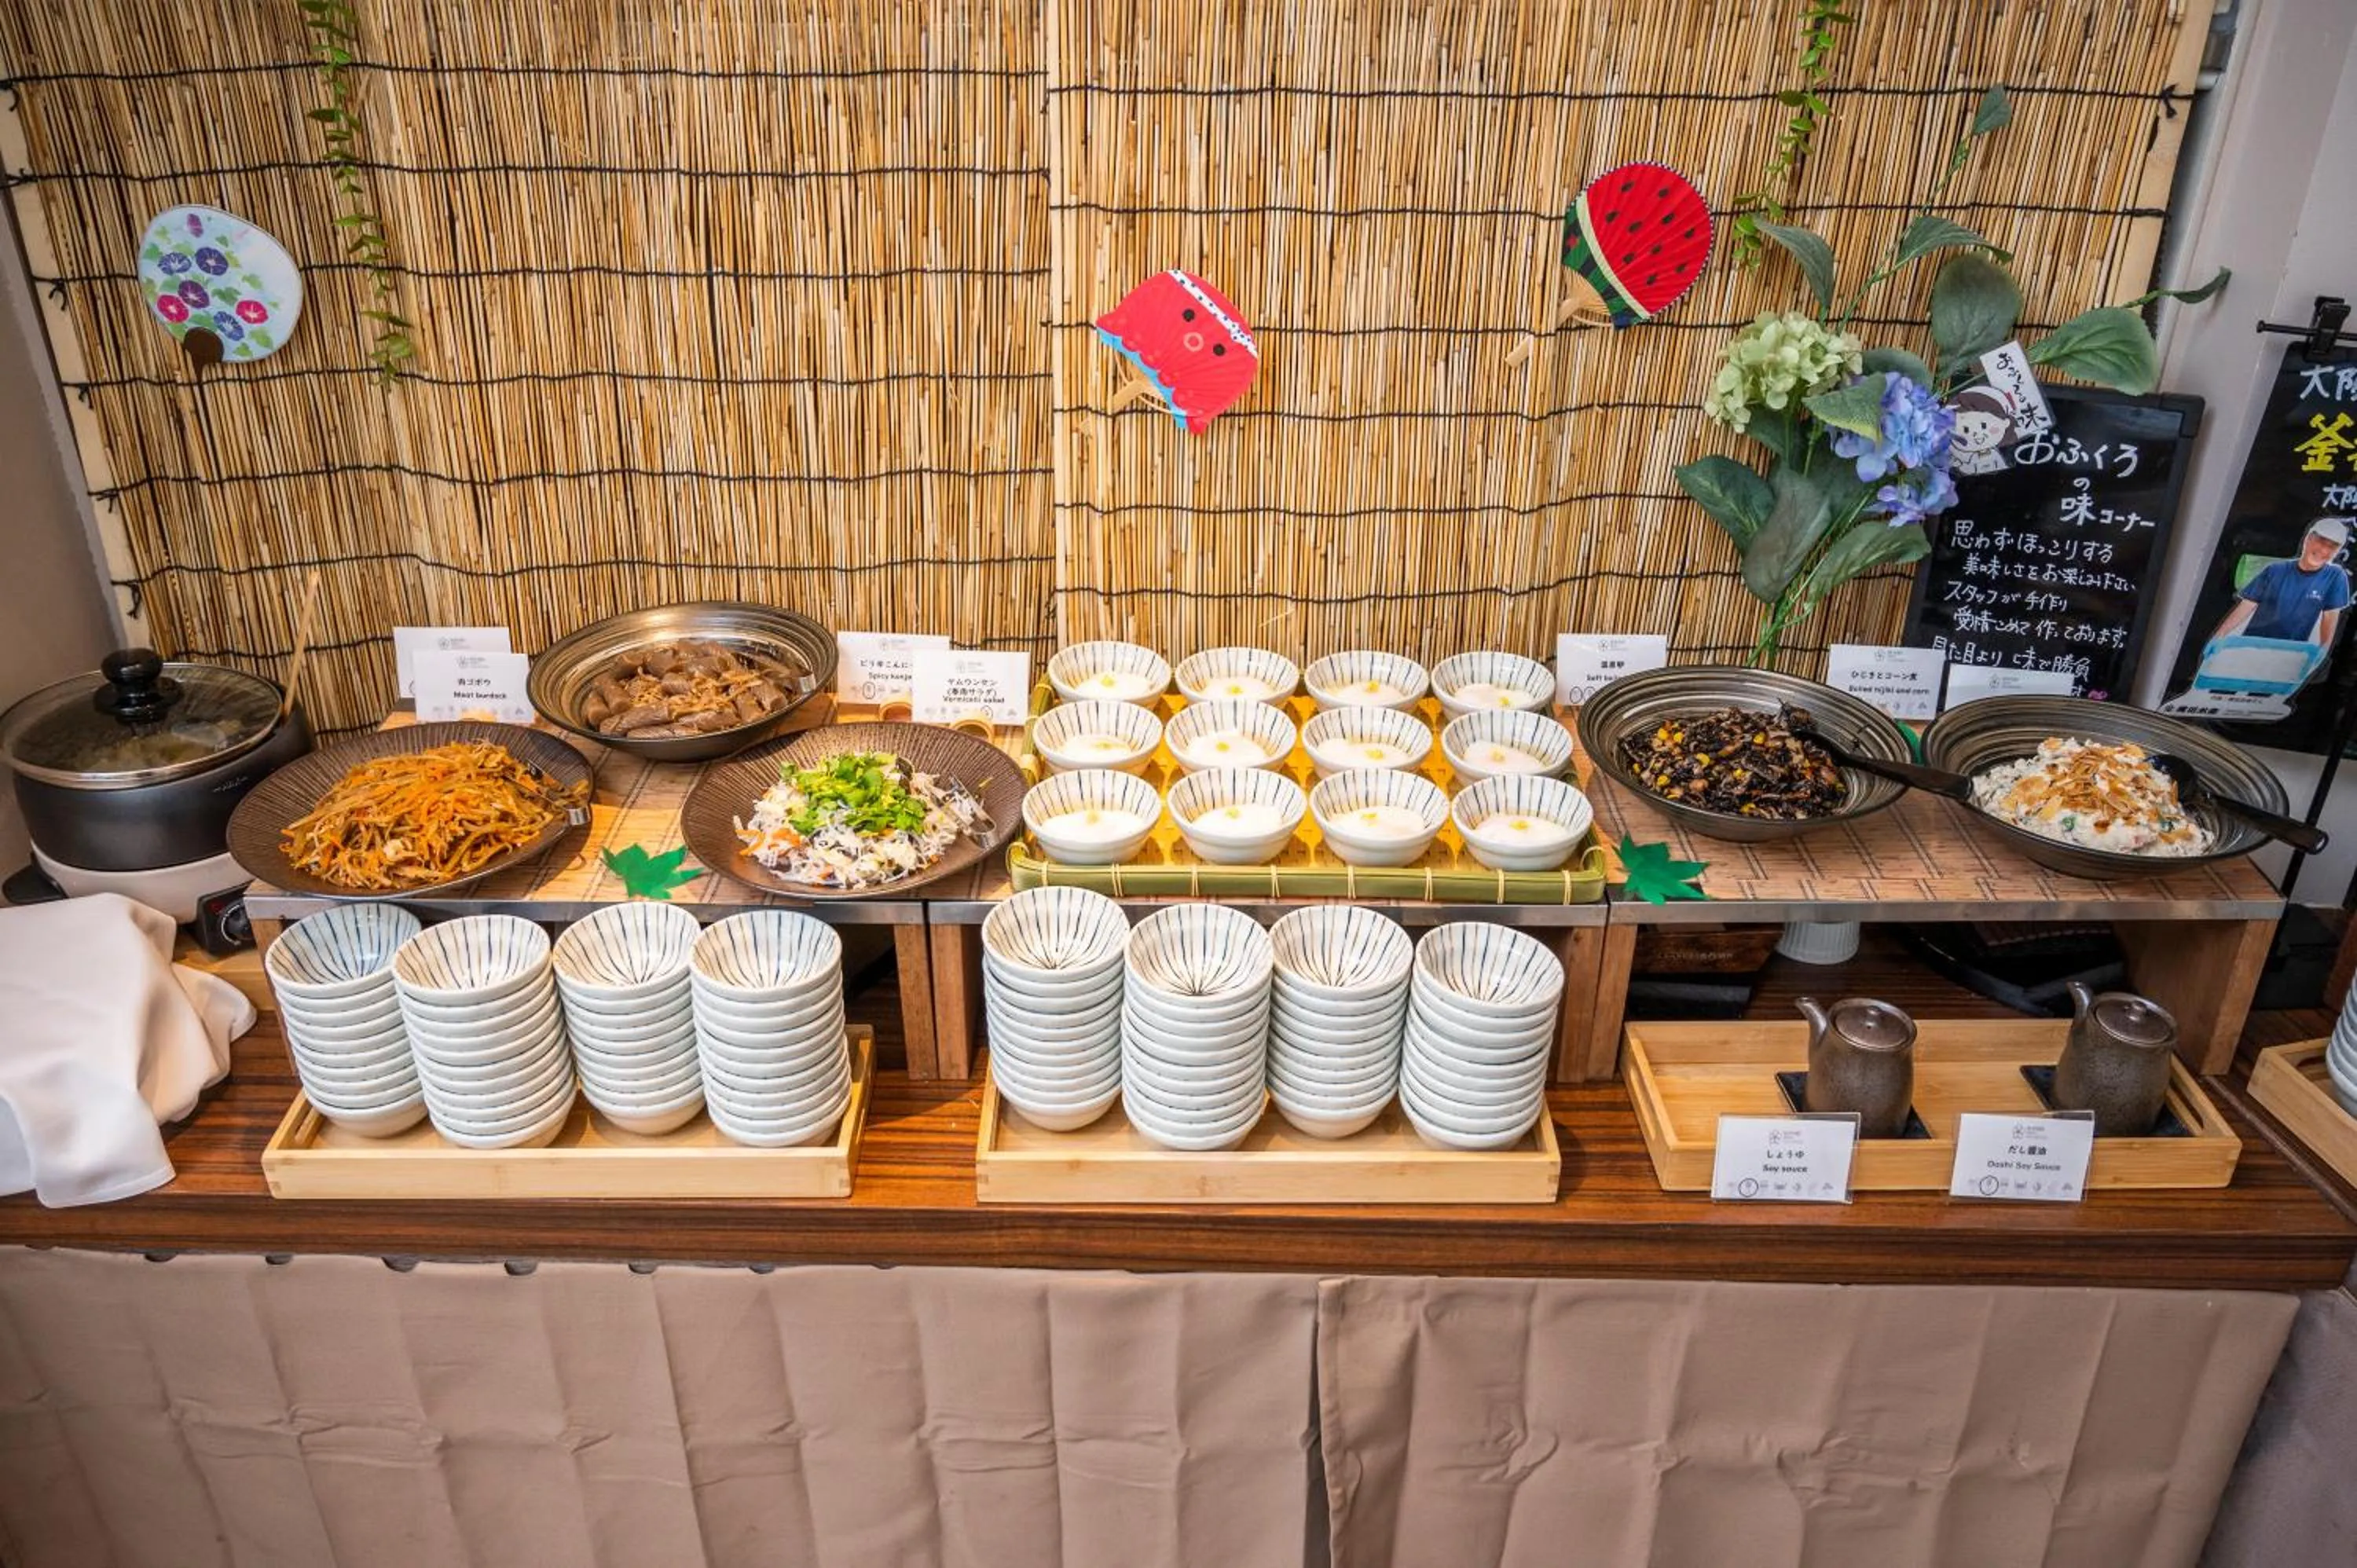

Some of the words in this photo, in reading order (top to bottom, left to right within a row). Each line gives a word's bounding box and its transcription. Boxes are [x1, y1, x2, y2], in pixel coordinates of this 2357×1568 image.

[2014, 430, 2139, 477] おふくろ
[2293, 412, 2357, 471] 釜
[1951, 519, 2113, 563] 思わずほっこりする
[860, 659, 912, 669] ピリ辛こんに
[1762, 1163, 1780, 1174] Soy
